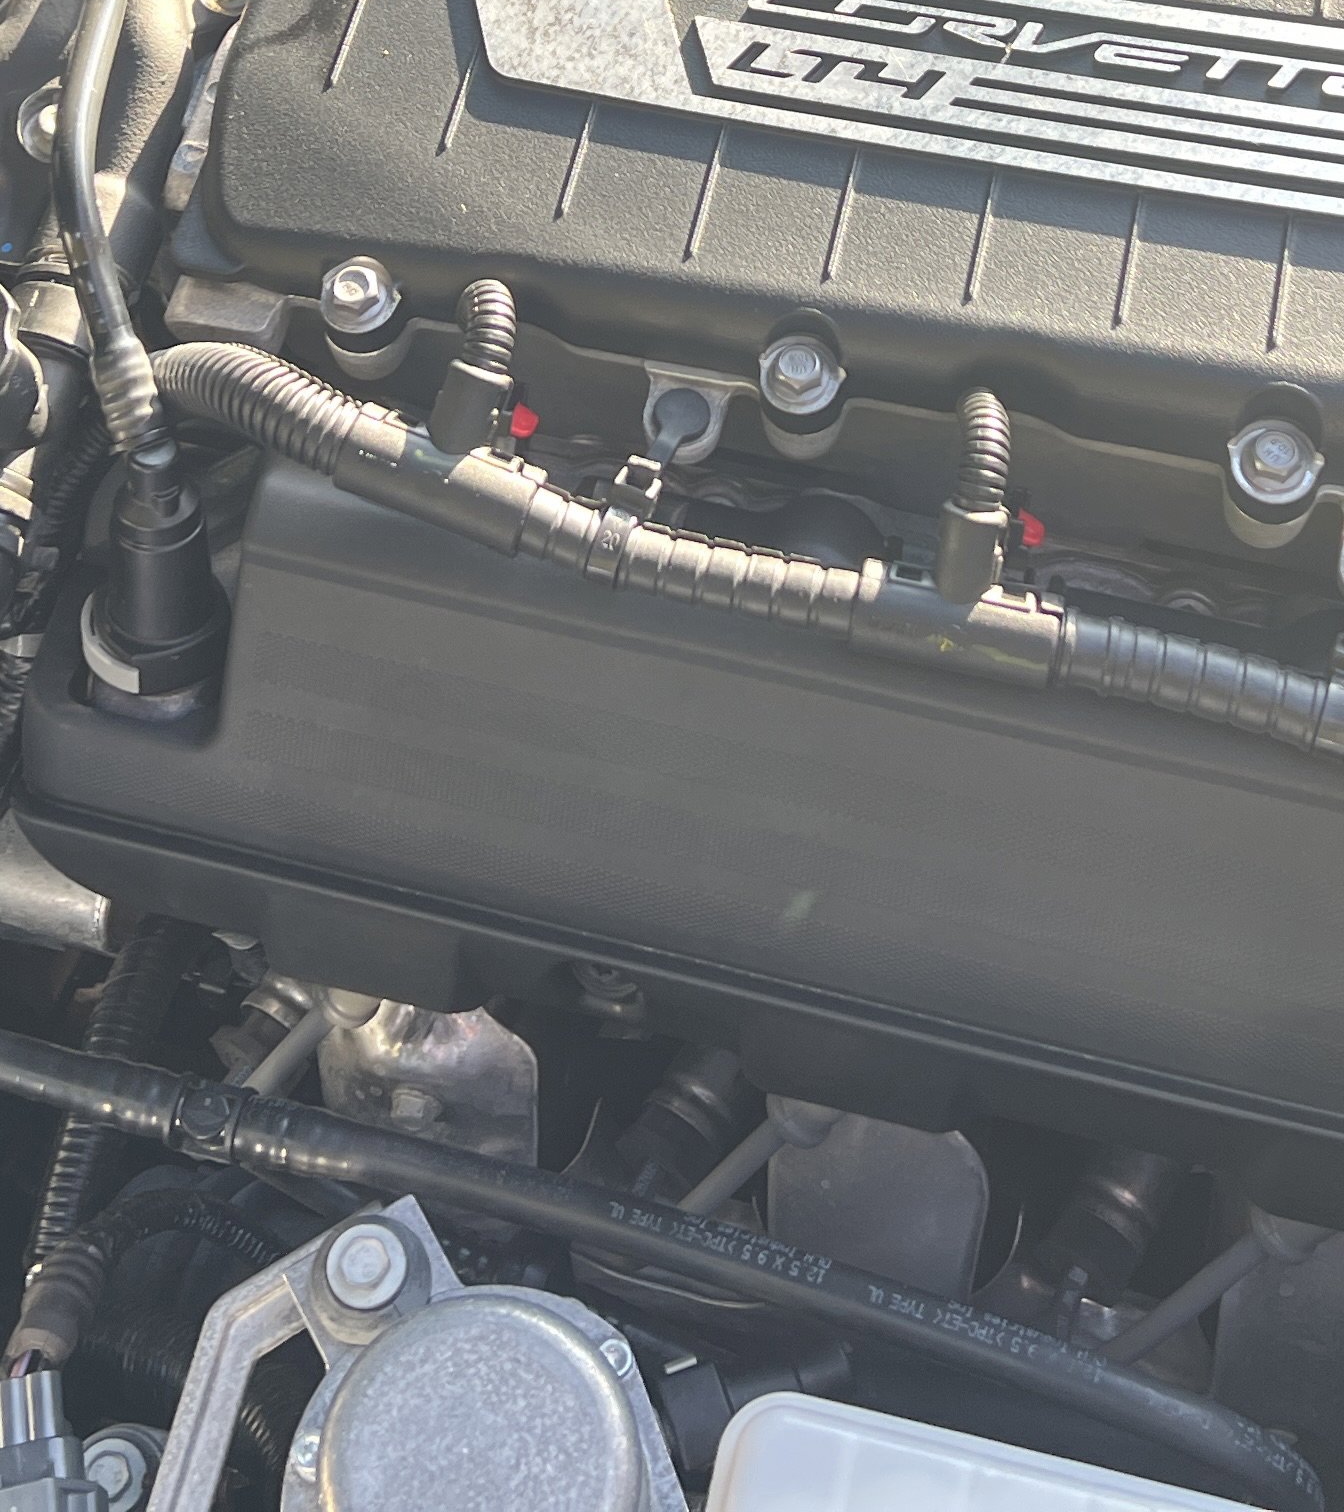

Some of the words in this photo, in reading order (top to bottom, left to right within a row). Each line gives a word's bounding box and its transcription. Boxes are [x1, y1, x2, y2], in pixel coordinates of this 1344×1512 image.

[726, 41, 946, 101] LT4
[629, 1208, 663, 1232] TYPE
[868, 1284, 884, 1304] UL
[888, 1292, 925, 1319] TYPE
